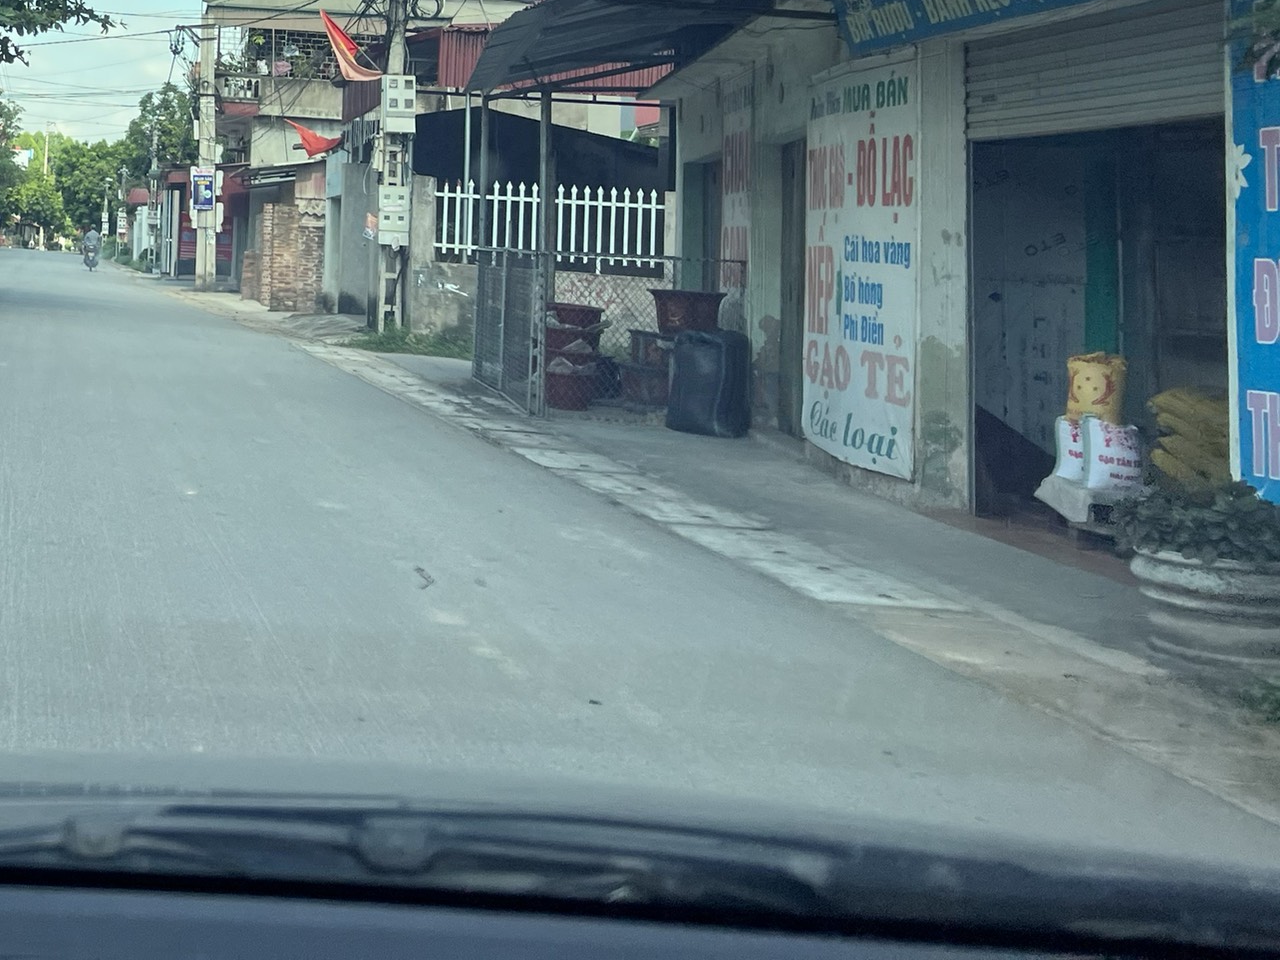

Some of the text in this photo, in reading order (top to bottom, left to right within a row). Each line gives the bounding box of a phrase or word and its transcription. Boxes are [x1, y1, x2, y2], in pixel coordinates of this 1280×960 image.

[842, 83, 871, 114] MUA
[875, 70, 909, 108] BÁN
[881, 133, 914, 224] LẠC
[808, 211, 835, 335] NẾP
[844, 234, 911, 269] Cái hoa vàng
[806, 334, 910, 408] GẠO TẺ
[810, 401, 899, 465] Các loại
